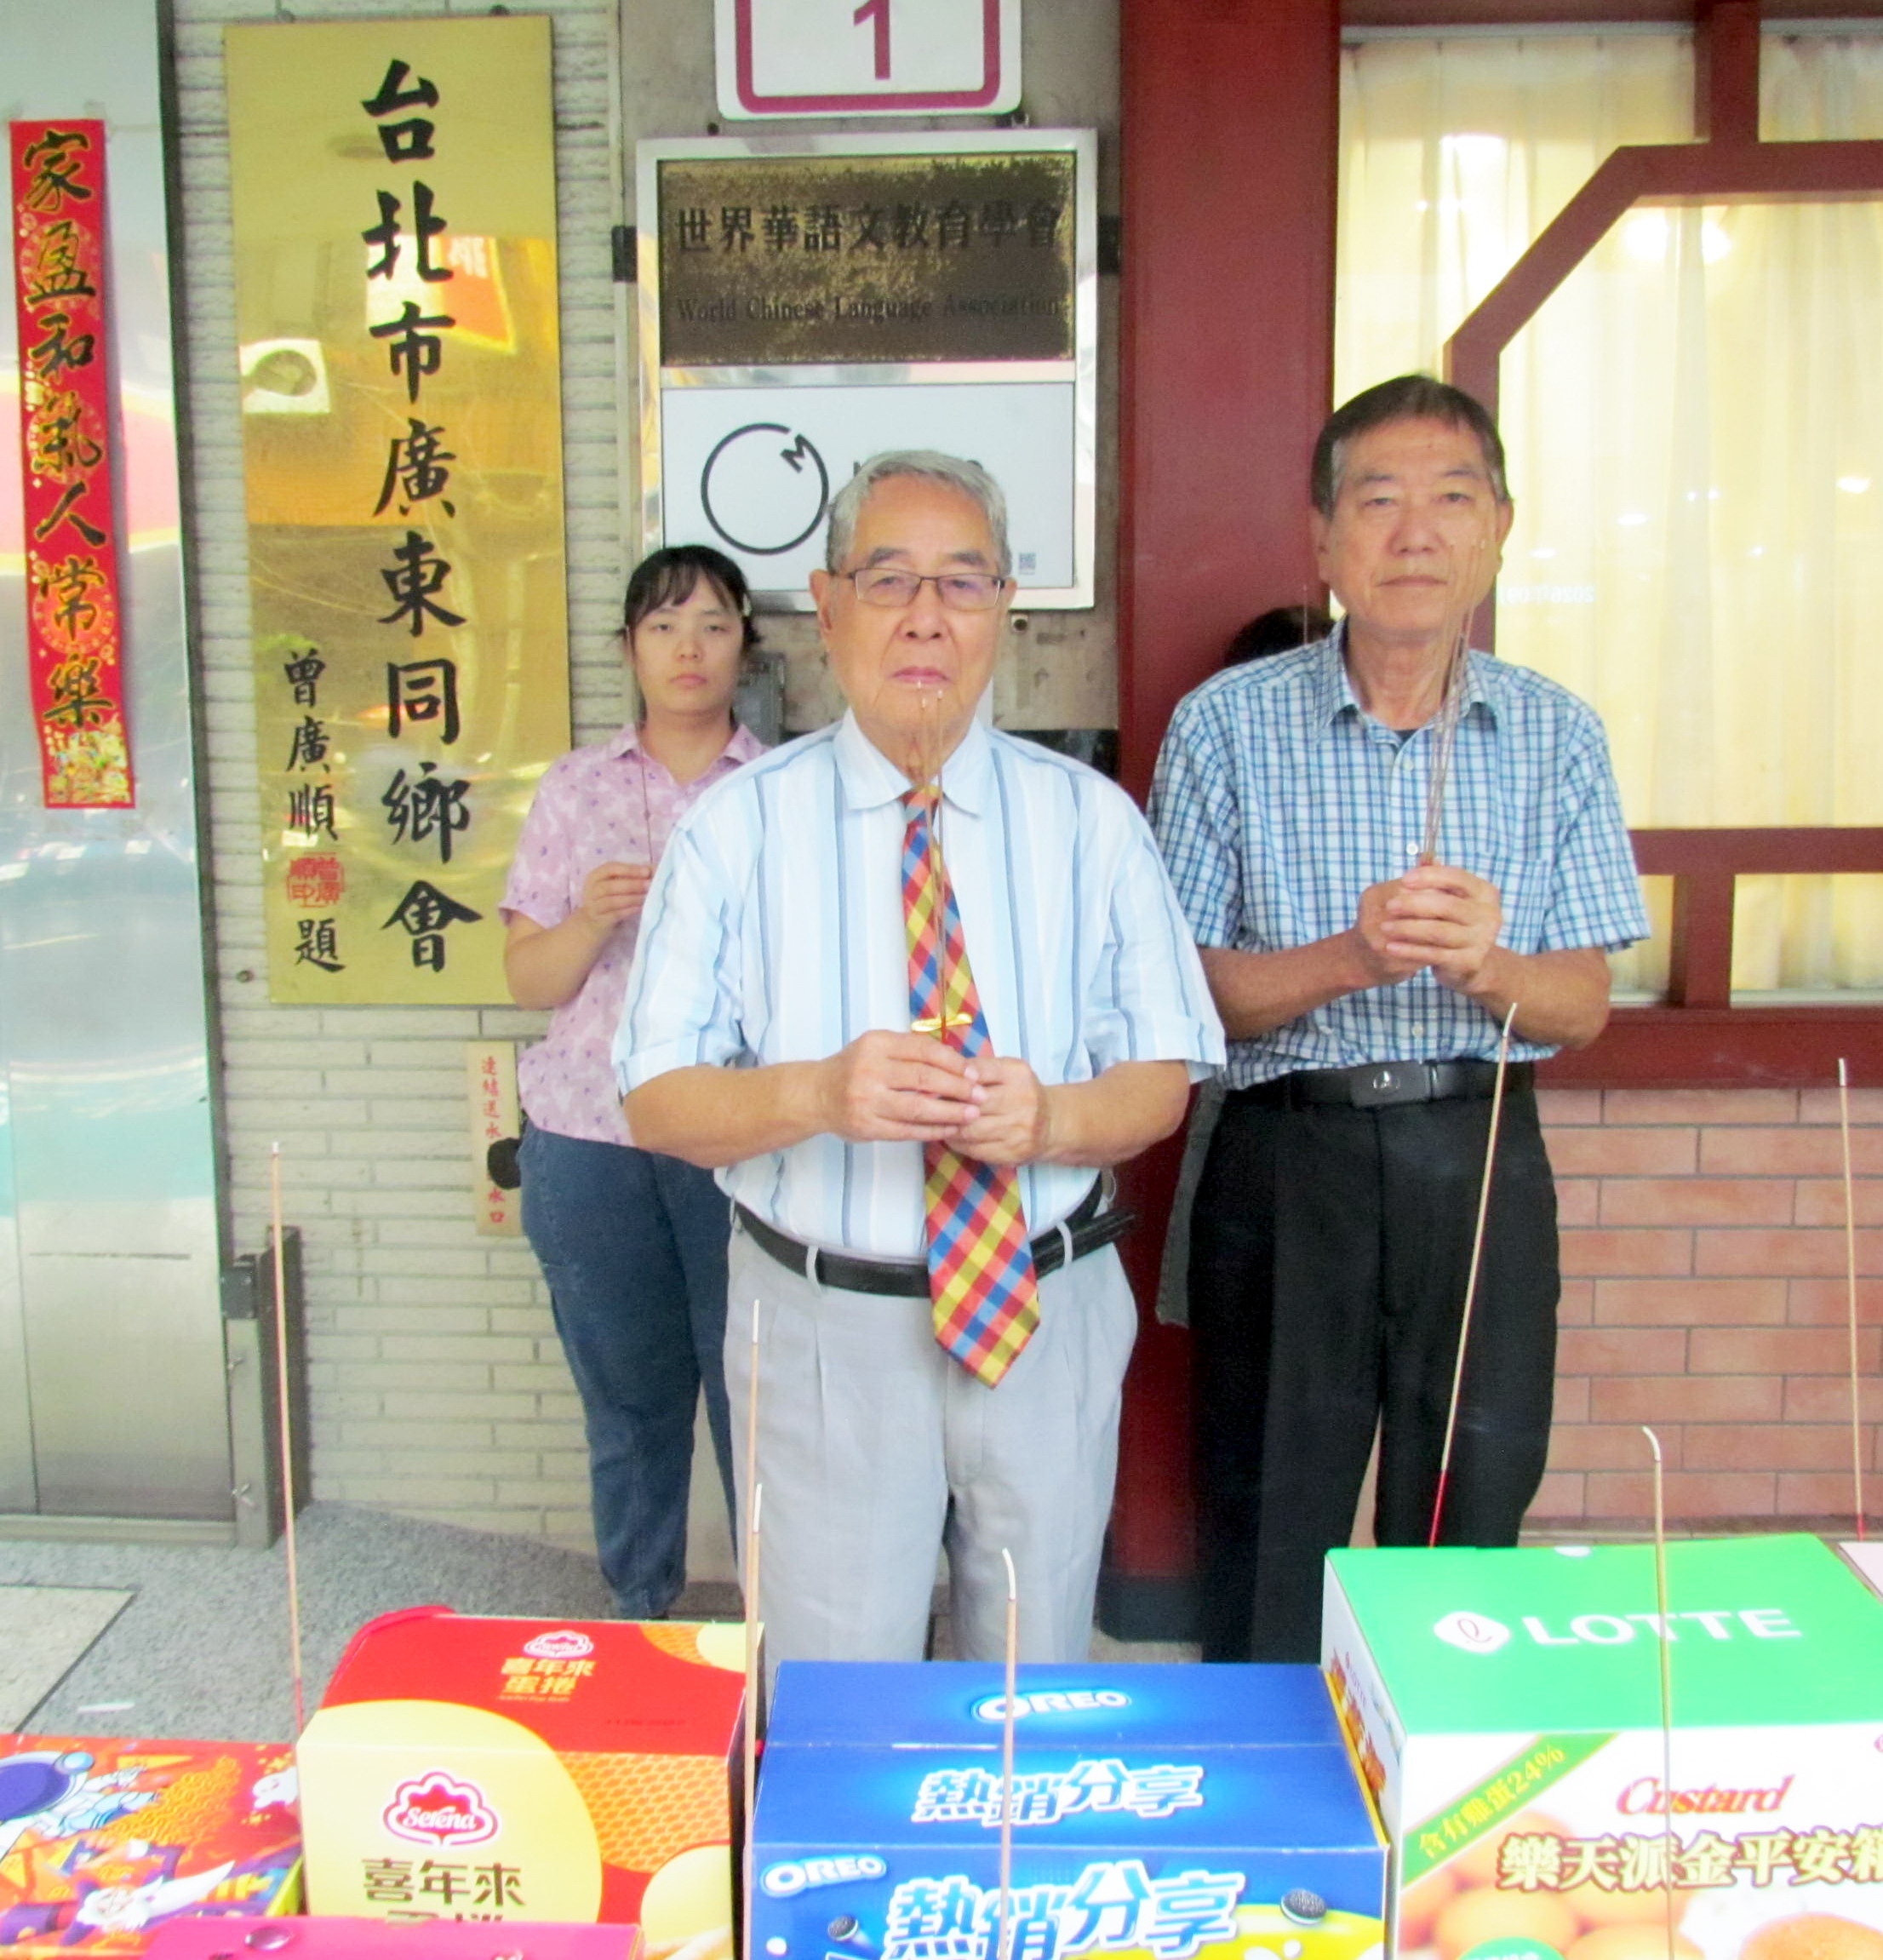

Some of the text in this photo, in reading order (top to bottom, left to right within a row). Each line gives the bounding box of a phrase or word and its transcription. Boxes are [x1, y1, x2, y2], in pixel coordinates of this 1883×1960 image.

[854, 0, 890, 80] 1
[676, 198, 1061, 252] 世界華語文教育學會
[679, 298, 736, 321] World
[748, 296, 825, 320] Chinese
[833, 295, 932, 324] Language
[362, 59, 483, 972] 台北市廣東同鄉會
[482, 1056, 505, 1223] 連結送水水口
[1522, 1609, 1802, 1645] LOTTE
[979, 1689, 1128, 1721] OREO
[403, 1805, 478, 1831] Serena
[911, 1759, 1204, 1827] 熱銷分享
[1617, 1774, 1794, 1815] Custard
[361, 1857, 527, 1907] 喜年來
[764, 1856, 884, 1894] OREO
[881, 1860, 1246, 1960] 熱銷分享
